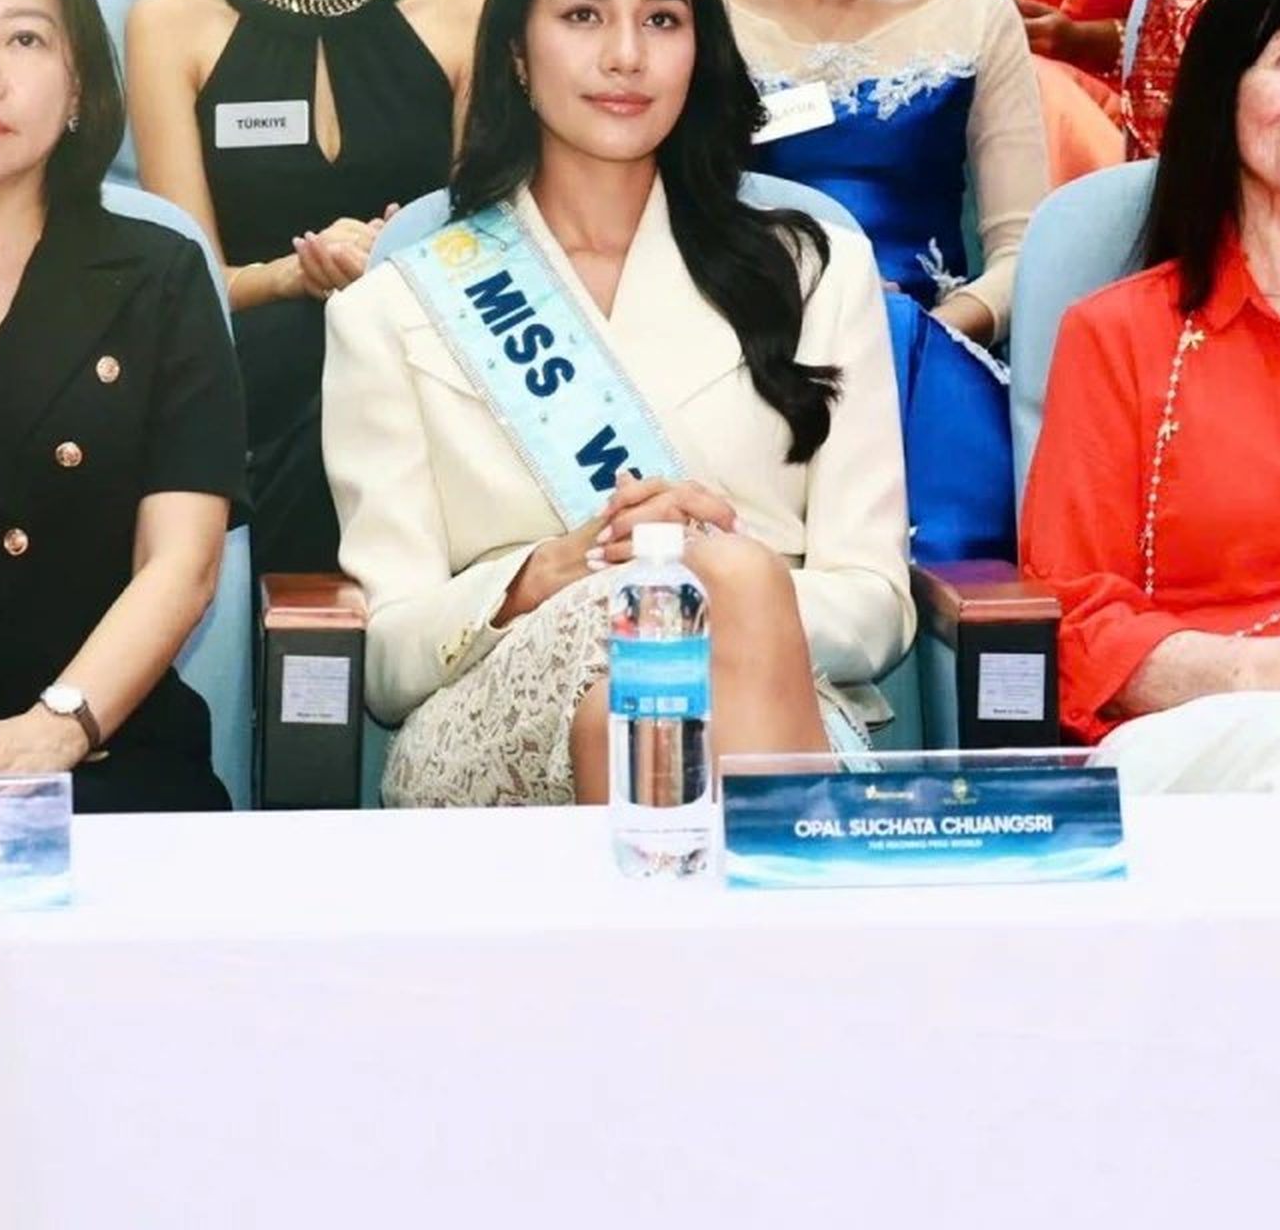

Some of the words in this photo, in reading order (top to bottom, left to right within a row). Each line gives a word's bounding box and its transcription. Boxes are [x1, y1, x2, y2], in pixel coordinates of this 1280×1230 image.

[464, 269, 575, 398] MISS
[794, 819, 845, 838] OPAL
[849, 817, 937, 836] SUCHATA
[940, 814, 1054, 835] CHUANGSRI
